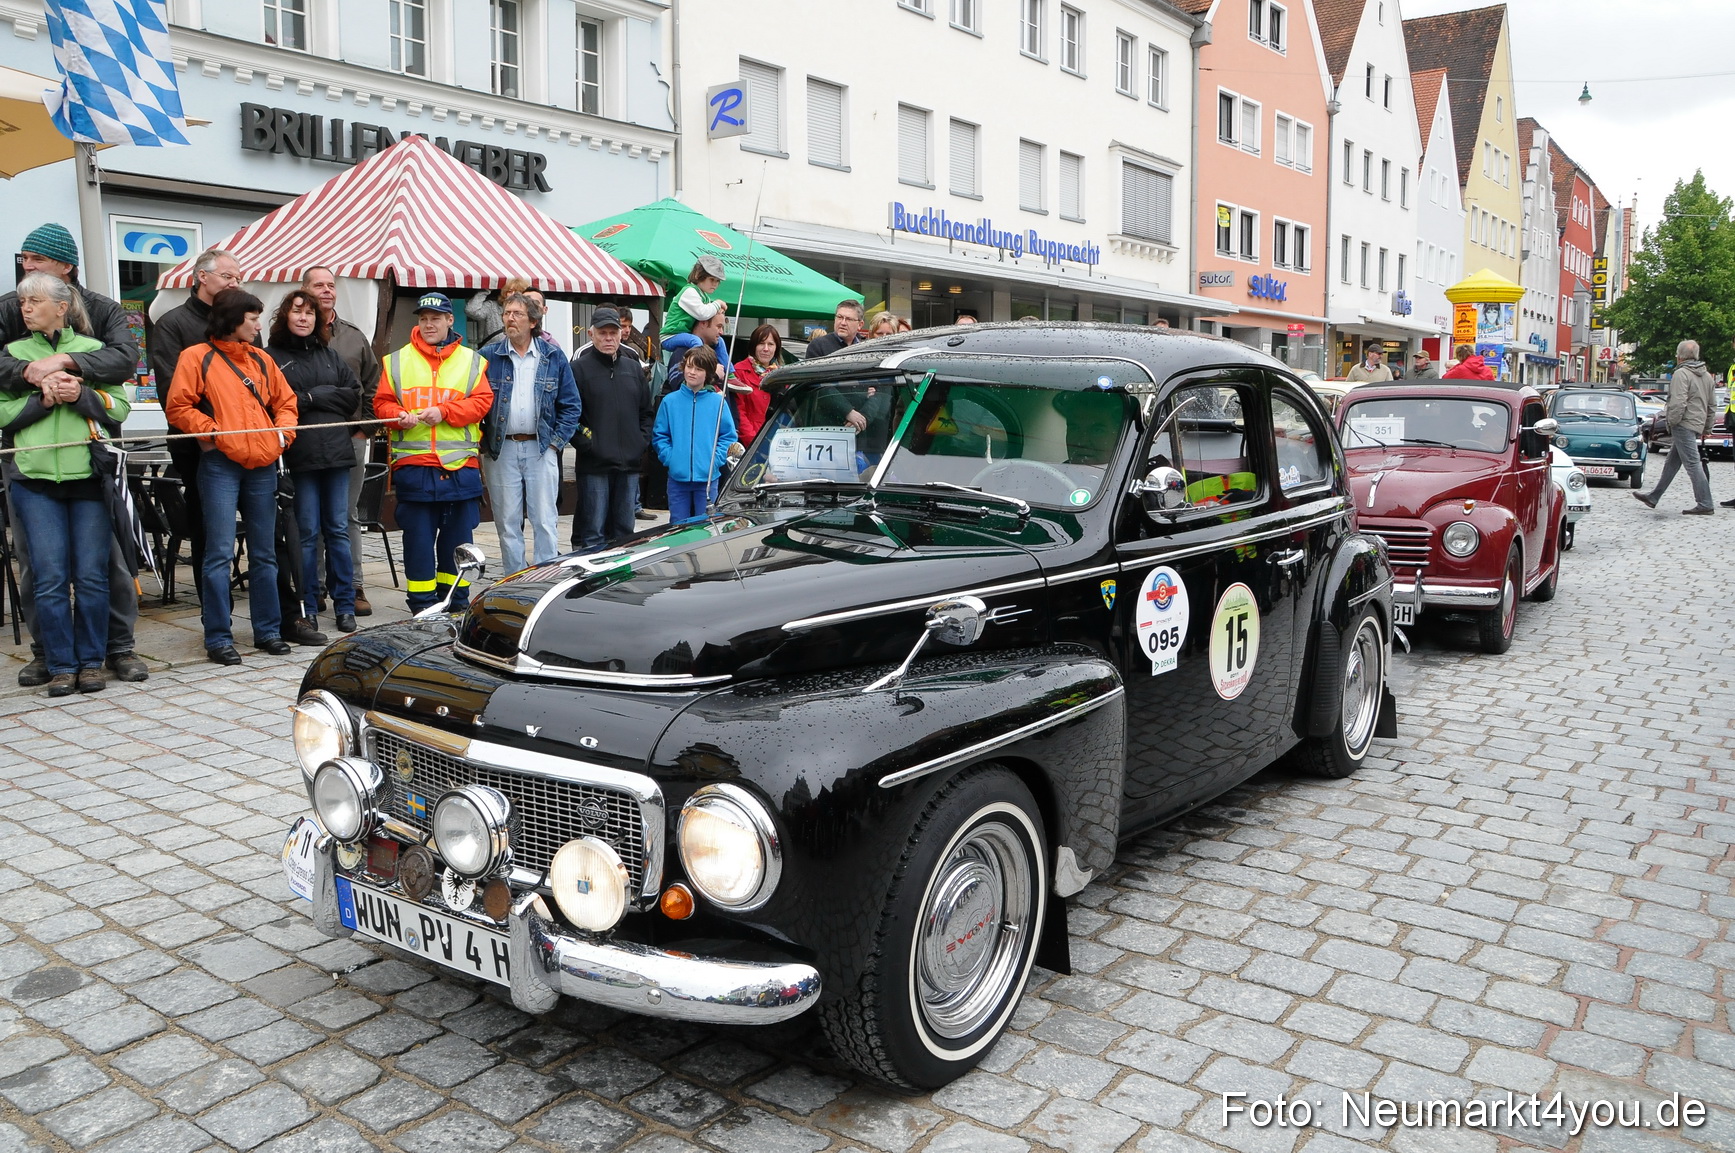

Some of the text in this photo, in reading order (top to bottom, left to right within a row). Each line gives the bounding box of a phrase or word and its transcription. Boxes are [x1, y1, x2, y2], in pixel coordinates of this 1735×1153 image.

[894, 201, 1100, 265] Buchhandlung Rupprecht
[689, 250, 794, 276] mmsbräu
[420, 297, 442, 306] THW
[1591, 258, 1607, 329] HOTEL
[401, 387, 458, 408] THW
[1375, 426, 1392, 435] 351
[806, 444, 833, 461] 171
[1149, 626, 1179, 654] 095
[1225, 612, 1249, 673] 15
[1160, 657, 1176, 667] DEKRA
[404, 696, 599, 749] VOLVO
[578, 807, 607, 819] VOLVO
[300, 829, 313, 859] 11
[345, 907, 352, 919] D
[352, 888, 402, 942] WUN
[418, 912, 453, 961] PV
